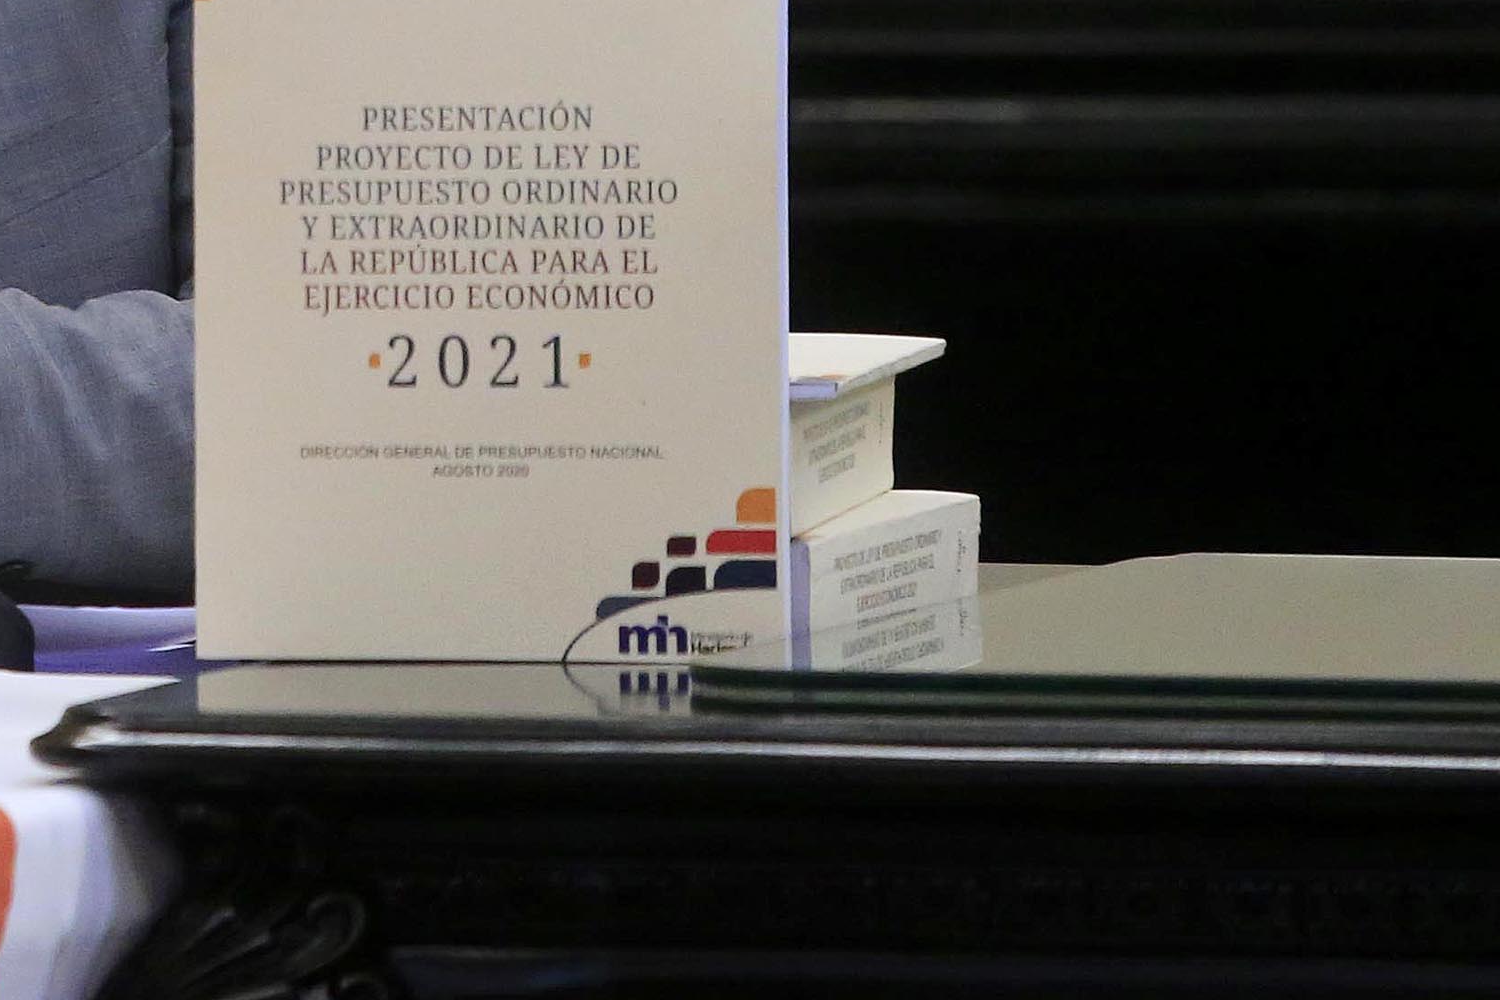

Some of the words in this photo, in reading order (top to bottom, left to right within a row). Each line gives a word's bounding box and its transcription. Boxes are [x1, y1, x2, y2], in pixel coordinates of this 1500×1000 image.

[362, 101, 593, 132] PRESENTACIÓN
[316, 144, 472, 171] PROYECTO
[484, 144, 523, 171] DE
[533, 144, 590, 171] LEY
[601, 144, 642, 171] DE
[280, 180, 490, 206] PRESUPUESTO
[502, 179, 678, 206] ORDINARIO
[301, 215, 319, 240] Y
[330, 215, 604, 241] EXTRAORDINARIO
[617, 215, 656, 240] DE
[300, 249, 339, 275] LA
[350, 243, 518, 275] REPÚBLICA
[531, 250, 609, 275] PARA
[622, 250, 659, 275] EL
[304, 284, 455, 318] EJERCICIO
[466, 279, 655, 311] ECONÓMICO
[387, 334, 570, 389] 2021
[383, 445, 450, 460] GENERAL
[454, 446, 473, 460] DE
[478, 446, 586, 460] PRESUPUESTO
[591, 446, 665, 460] NACIONAL
[432, 464, 493, 479] AGOSTO
